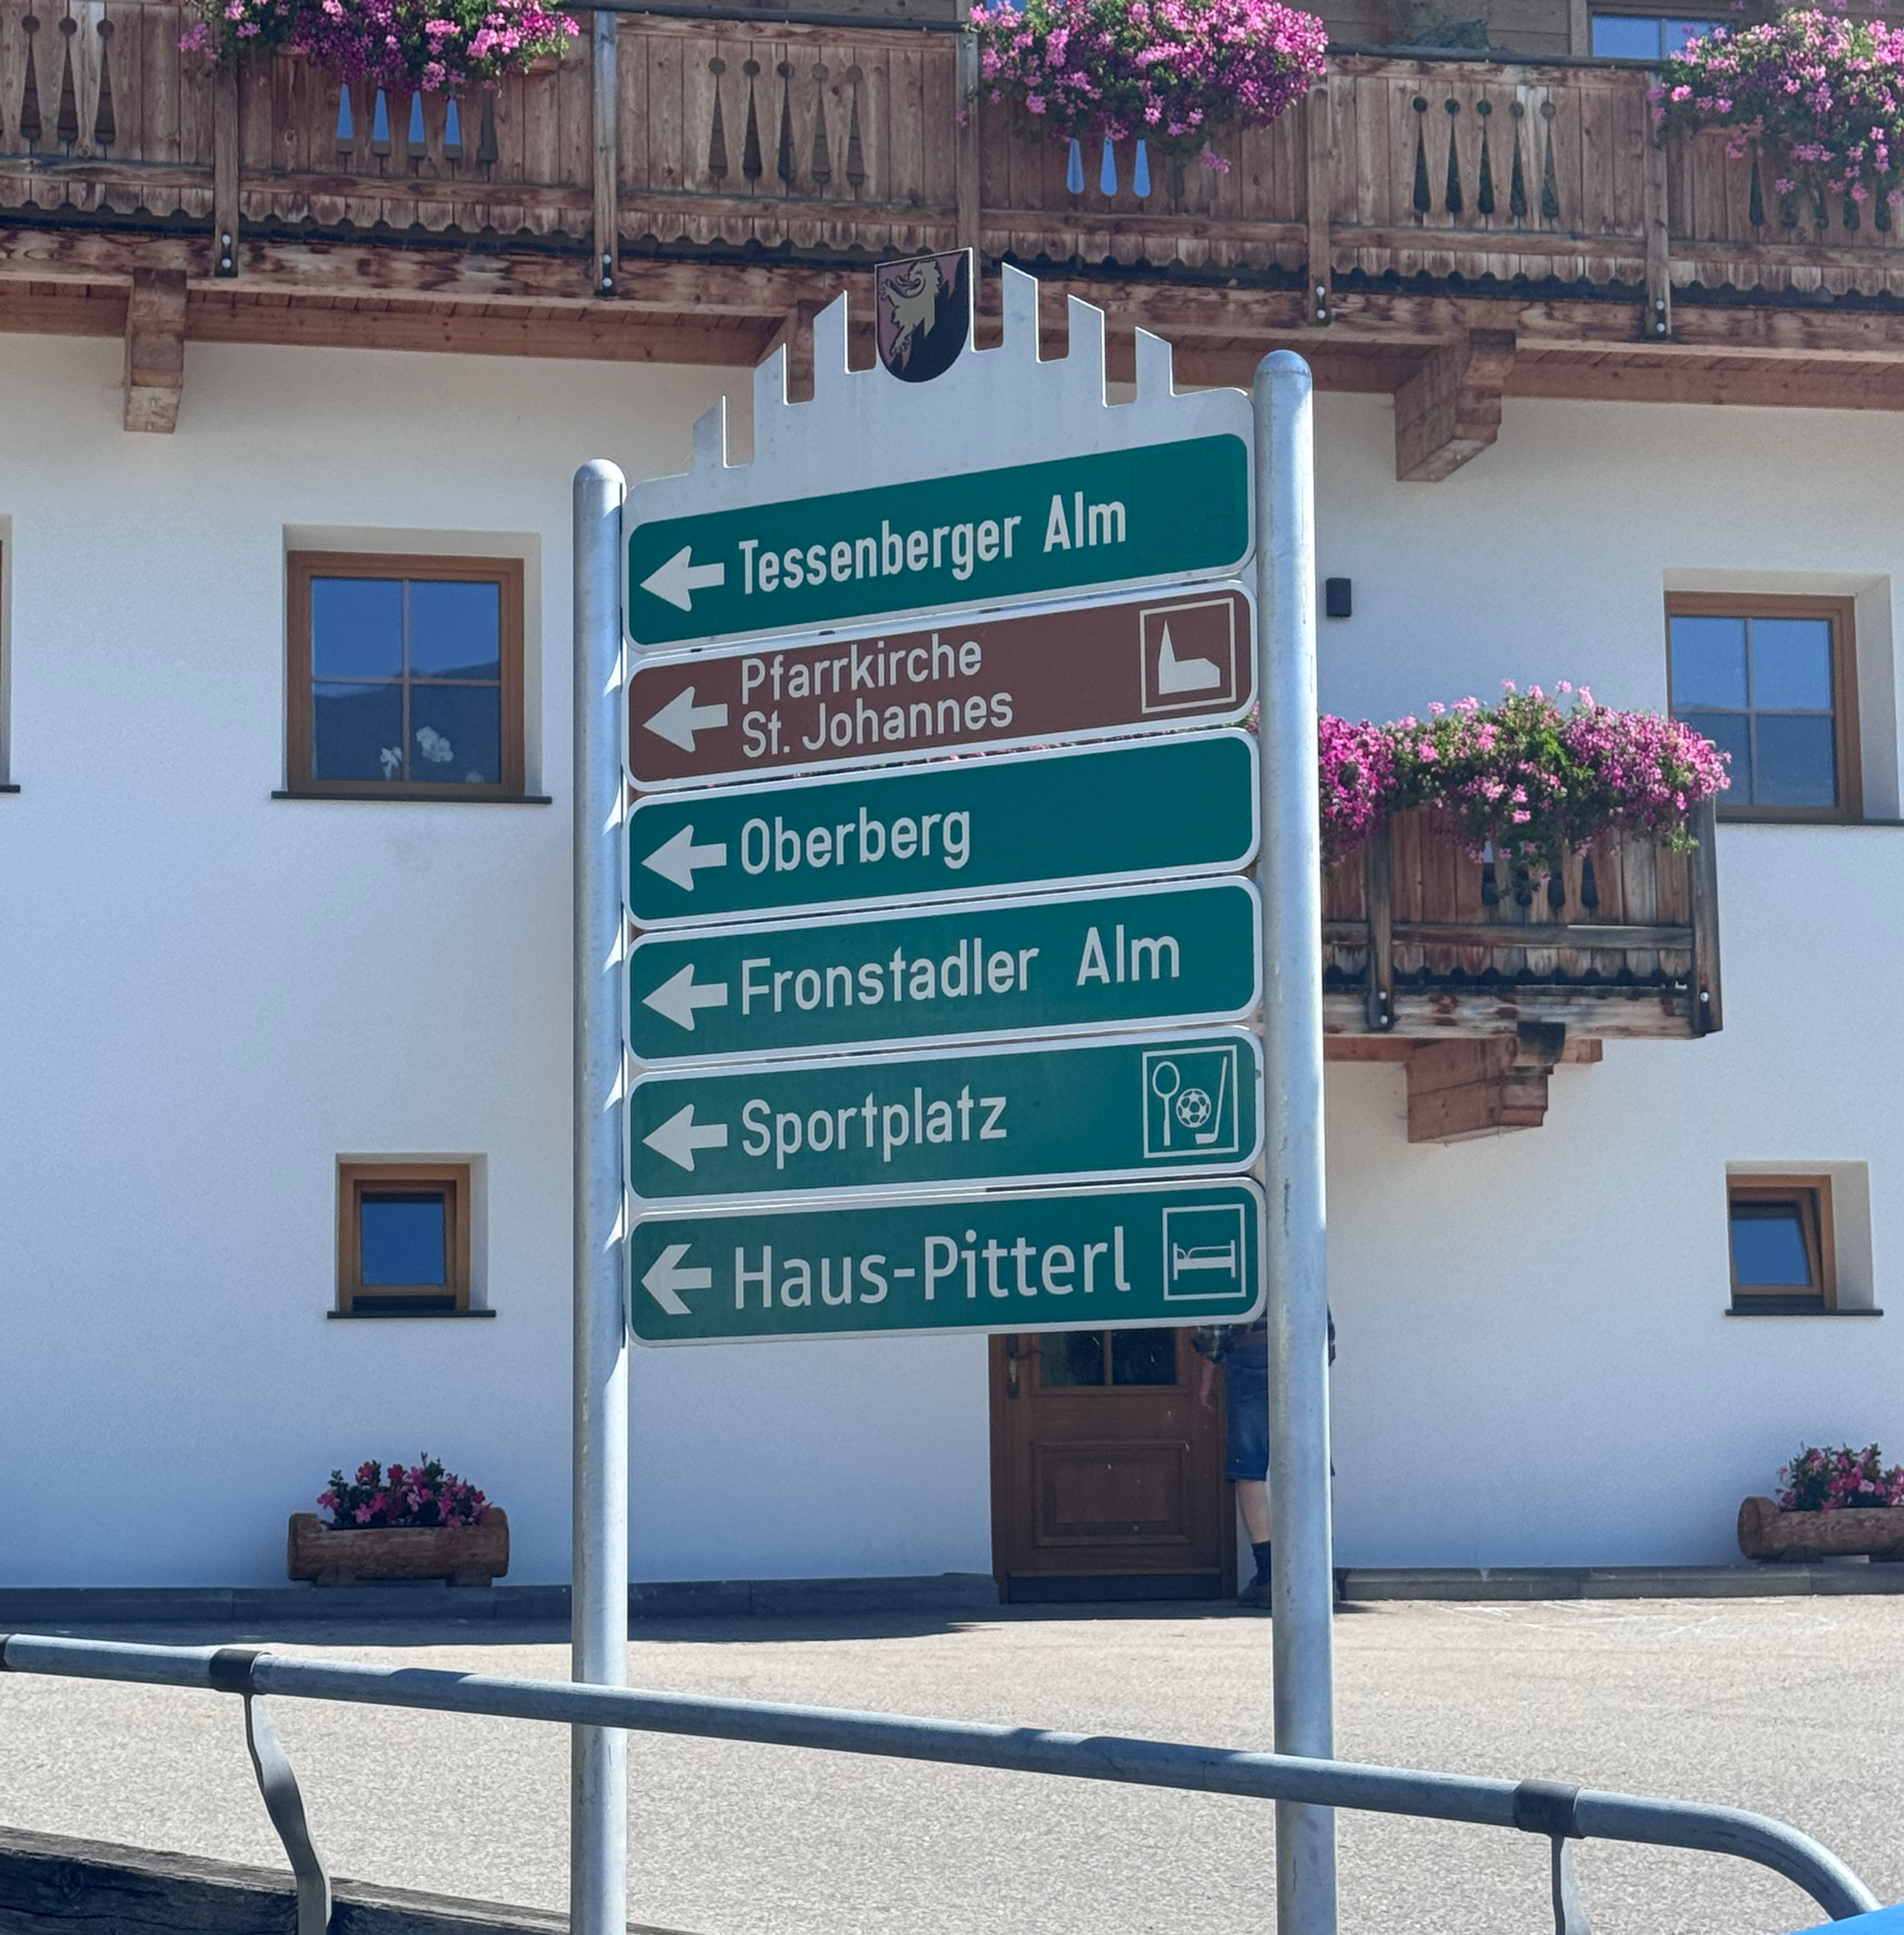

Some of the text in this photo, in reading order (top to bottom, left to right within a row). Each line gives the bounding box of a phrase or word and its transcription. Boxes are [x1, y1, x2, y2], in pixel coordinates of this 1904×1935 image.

[738, 492, 1127, 595] Tessenberger Alm
[740, 633, 983, 705] Pfarrkirche
[742, 692, 1014, 758] St. Johannes
[741, 807, 971, 874] Oberberg
[742, 924, 1181, 1015] Fronstadler Alm
[742, 1085, 1007, 1170] Sportplatz
[735, 1226, 1131, 1309] Haus-Pitterl
